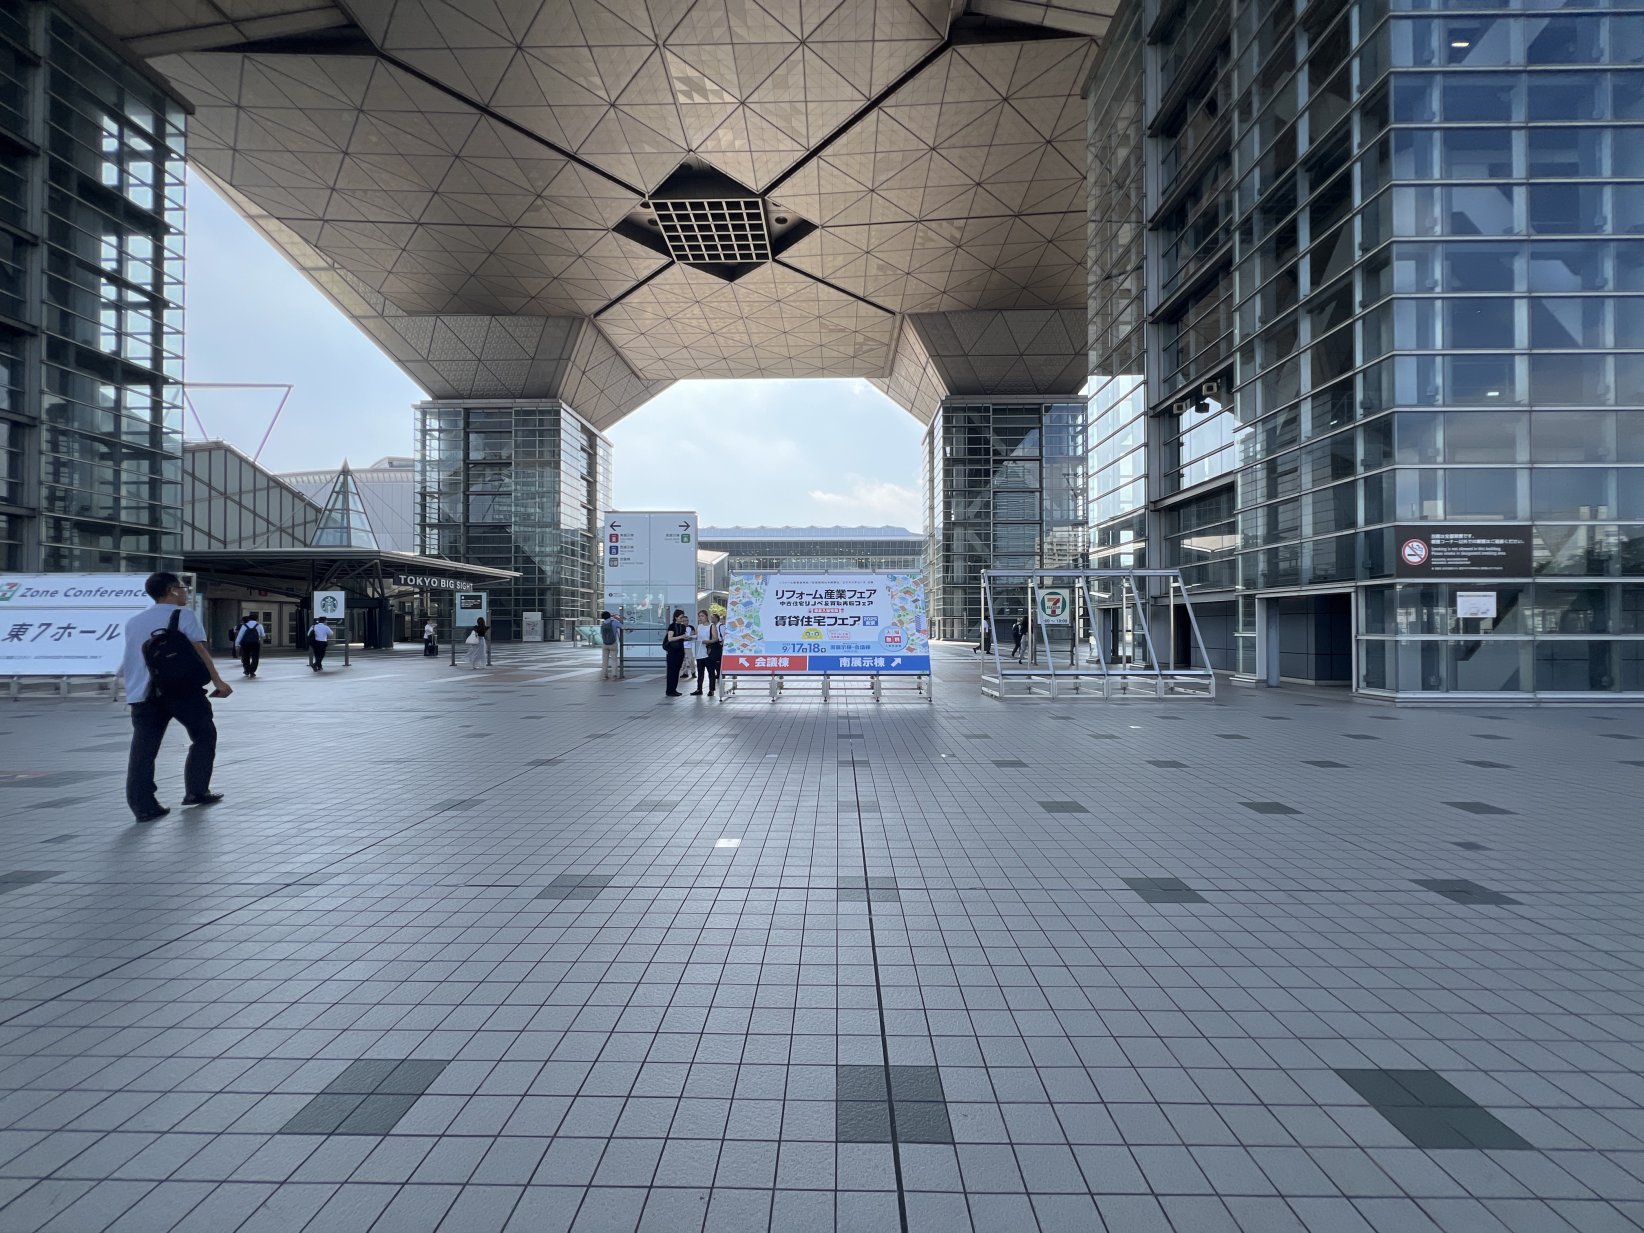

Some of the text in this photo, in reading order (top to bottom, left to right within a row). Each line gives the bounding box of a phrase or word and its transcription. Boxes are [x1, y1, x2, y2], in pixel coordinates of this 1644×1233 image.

[399, 575, 473, 590] TOKYO BIG SIGHT
[19, 587, 59, 598] Zone
[63, 587, 148, 598] Conference
[775, 589, 877, 600] リフォーム産業フェア
[774, 615, 861, 627] 賃貸住宅フェア
[2, 622, 121, 643] 東7ホール
[755, 657, 790, 668] 会議棟
[839, 657, 886, 668] 南展示棟
